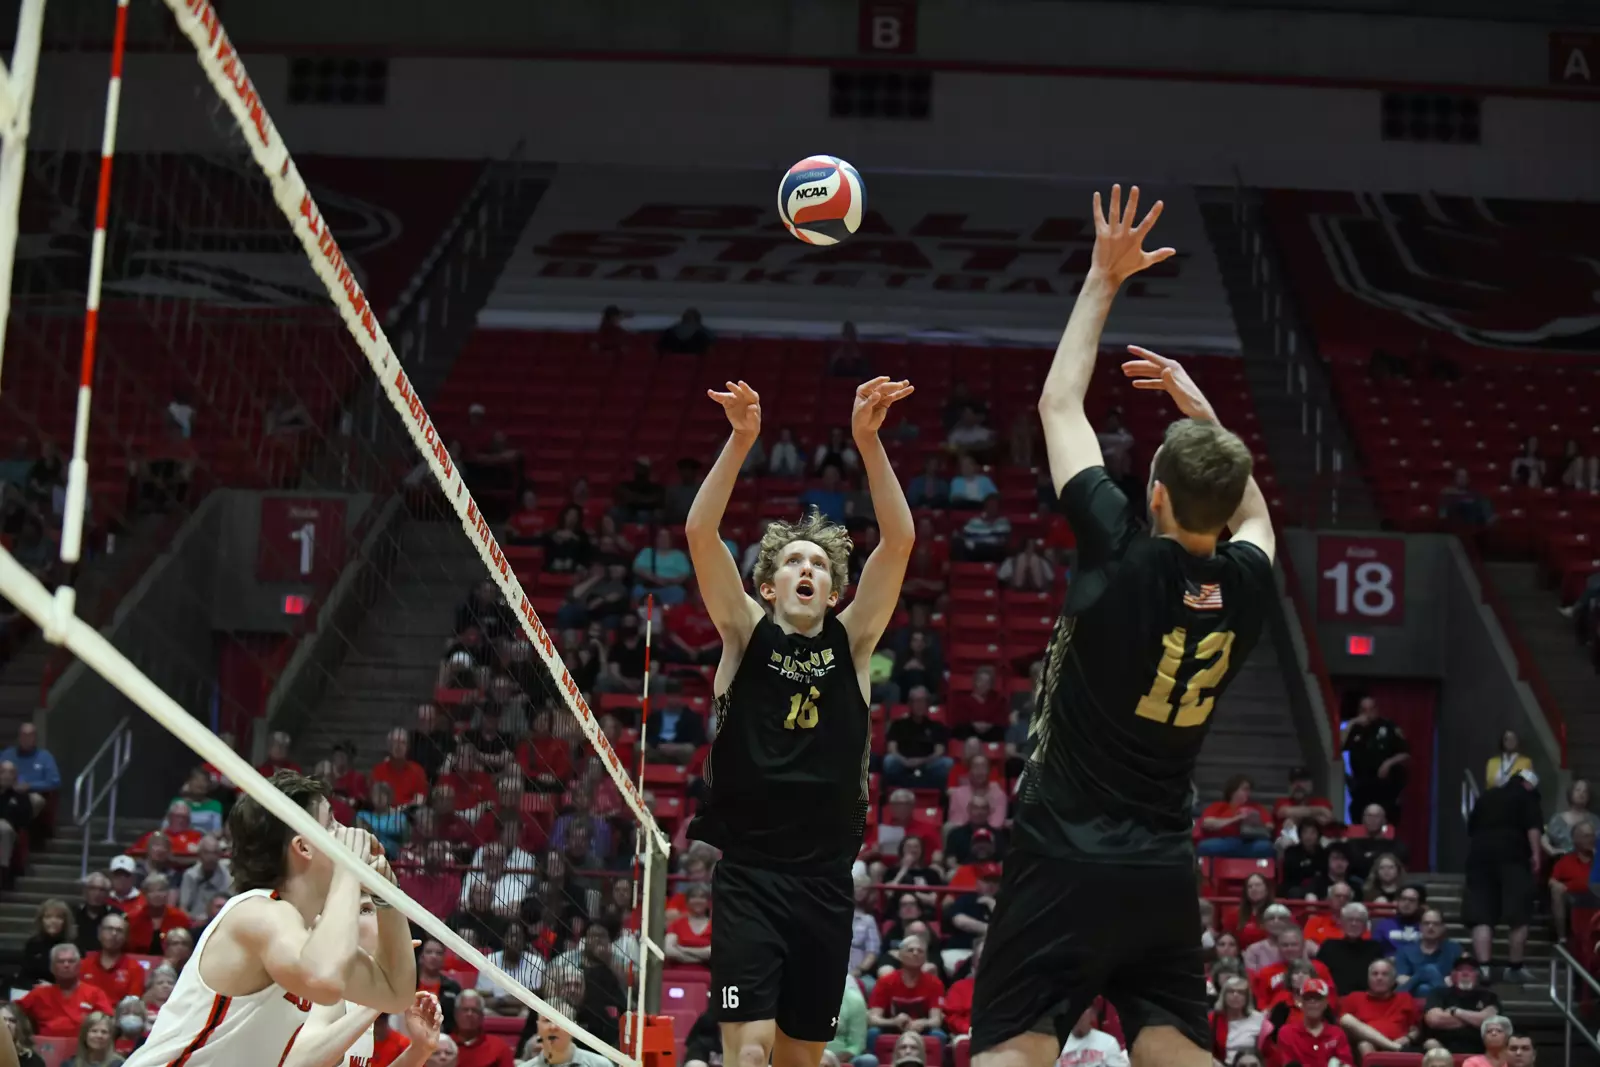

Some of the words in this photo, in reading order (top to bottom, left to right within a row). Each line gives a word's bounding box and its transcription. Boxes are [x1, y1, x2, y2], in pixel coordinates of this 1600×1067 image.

[872, 16, 901, 49] B
[1563, 47, 1591, 82] A
[796, 187, 828, 200] NCAA
[288, 522, 316, 575] 1
[1323, 561, 1395, 617] 18
[1134, 625, 1236, 728] 12
[783, 685, 820, 730] 16
[722, 985, 739, 1009] 16
